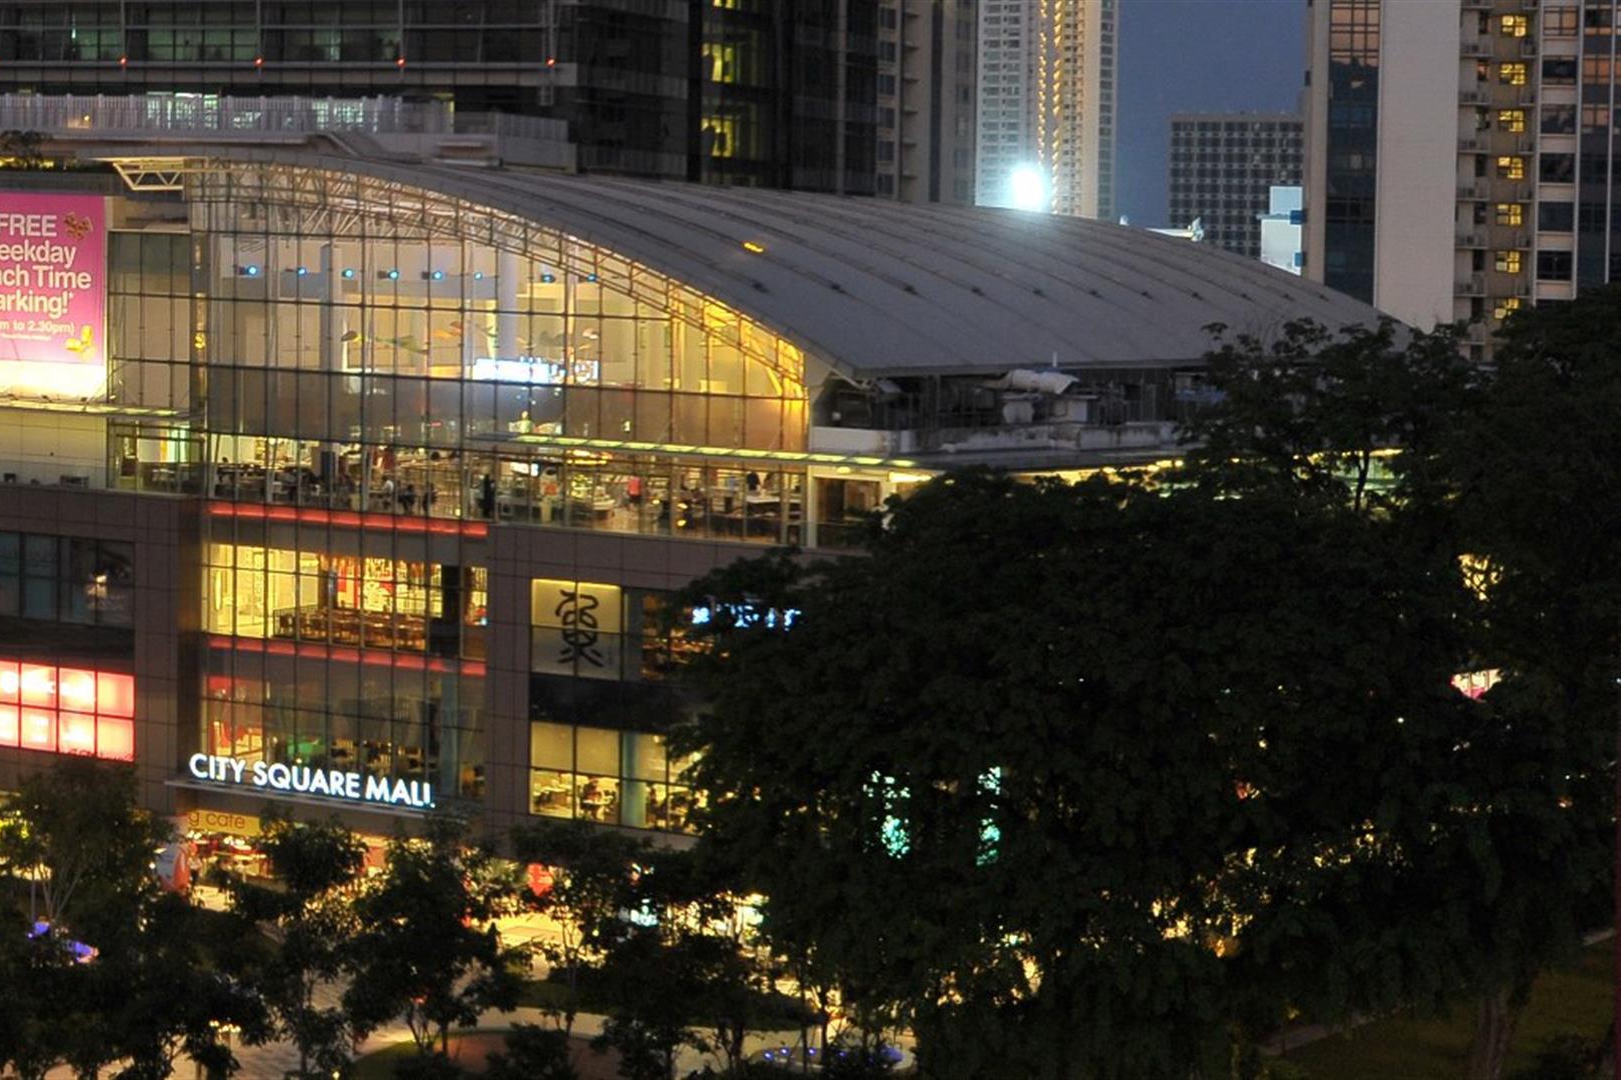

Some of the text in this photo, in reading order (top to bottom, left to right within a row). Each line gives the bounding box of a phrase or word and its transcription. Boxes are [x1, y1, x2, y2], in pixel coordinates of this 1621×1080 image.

[32, 265, 91, 289] Time
[13, 319, 25, 330] to
[27, 320, 75, 336] 2.30pm)
[189, 753, 436, 808] CITY SQUARE MALL
